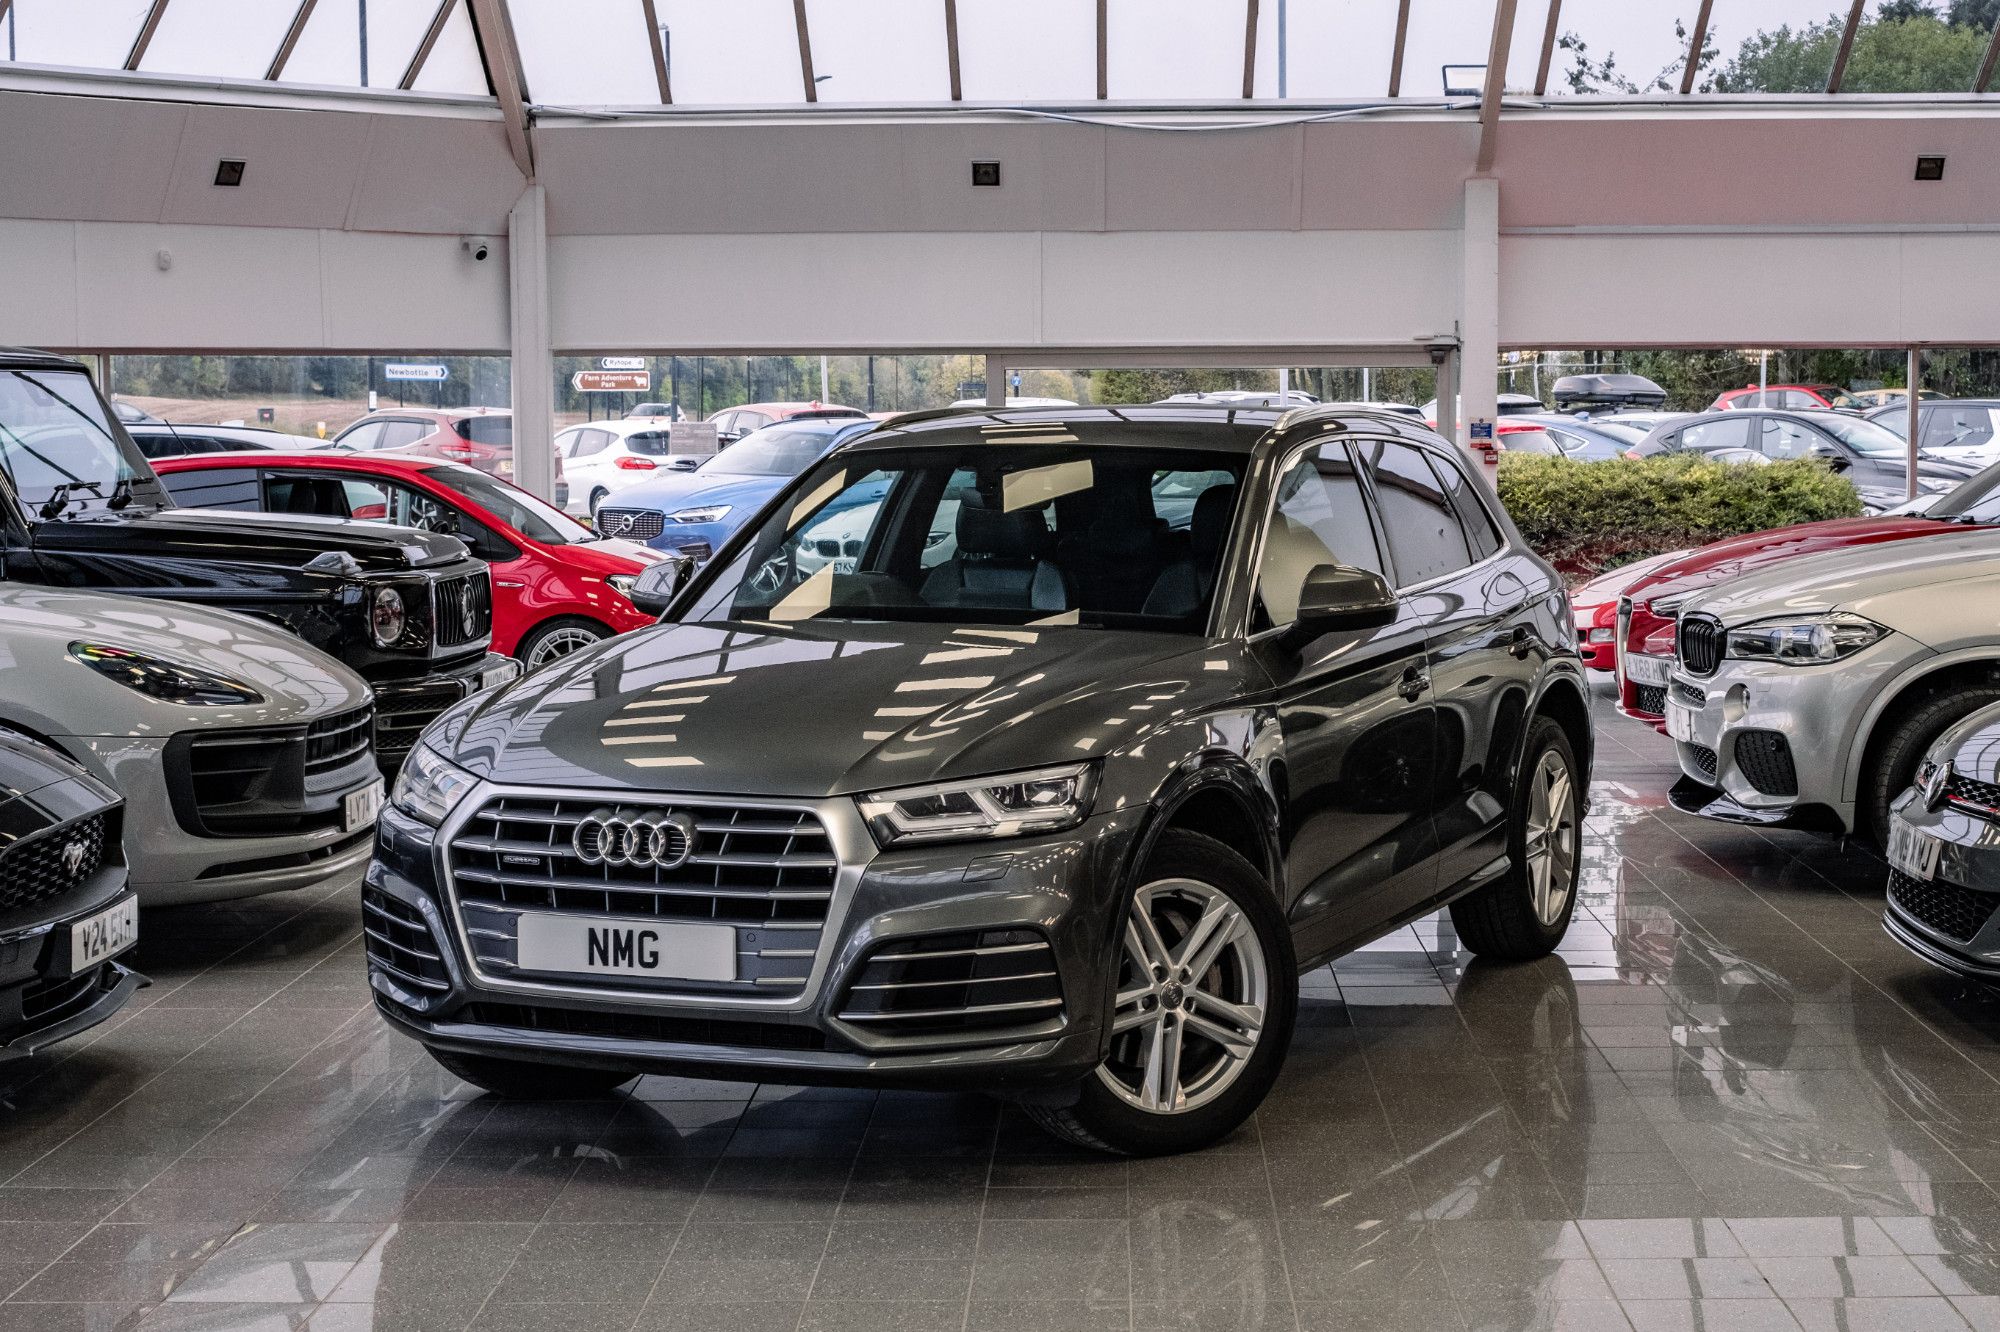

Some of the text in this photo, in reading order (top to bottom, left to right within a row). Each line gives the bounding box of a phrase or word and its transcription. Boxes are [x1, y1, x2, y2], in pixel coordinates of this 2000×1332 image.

[388, 368, 429, 376] Newbottle
[83, 917, 108, 960] V24
[588, 927, 659, 969] NMG
